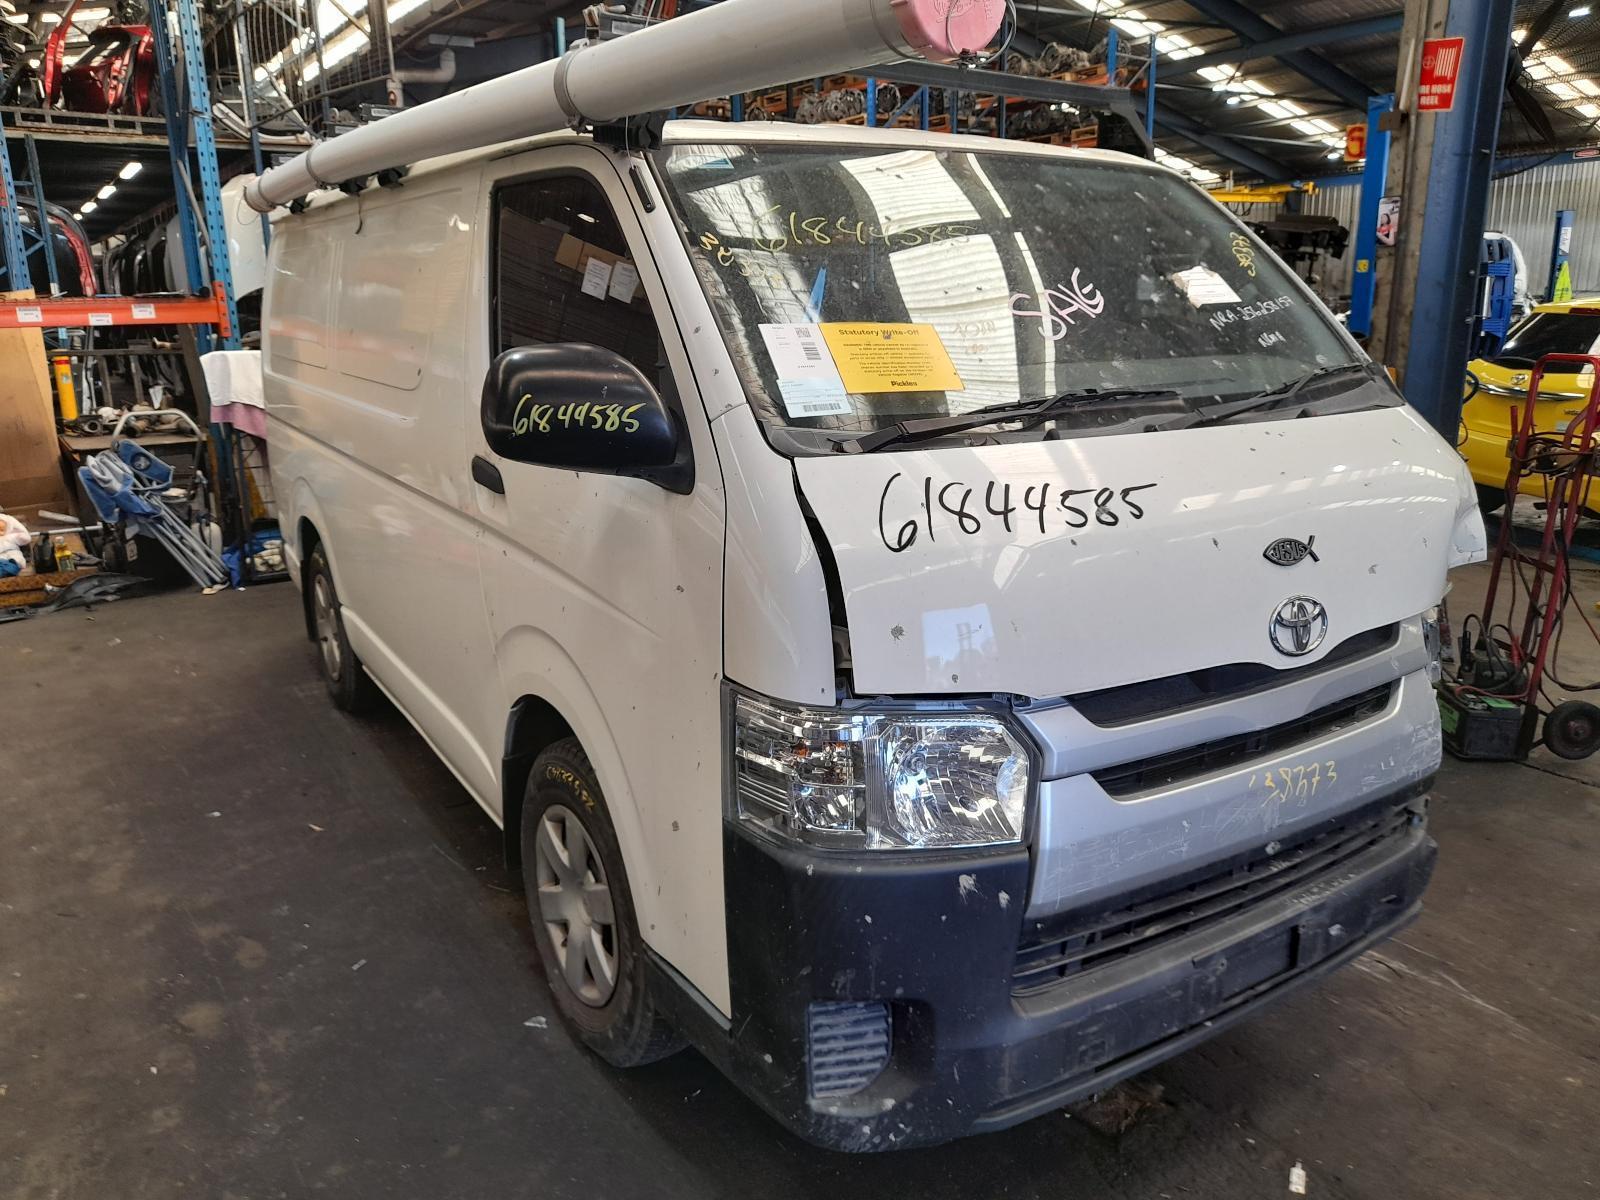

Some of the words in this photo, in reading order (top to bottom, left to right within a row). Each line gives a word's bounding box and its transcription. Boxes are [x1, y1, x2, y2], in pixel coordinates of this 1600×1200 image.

[838, 328, 879, 337] Statutory
[512, 393, 647, 437] 61844585
[879, 472, 1158, 553] 61844585
[1270, 541, 1306, 561] JESUS
